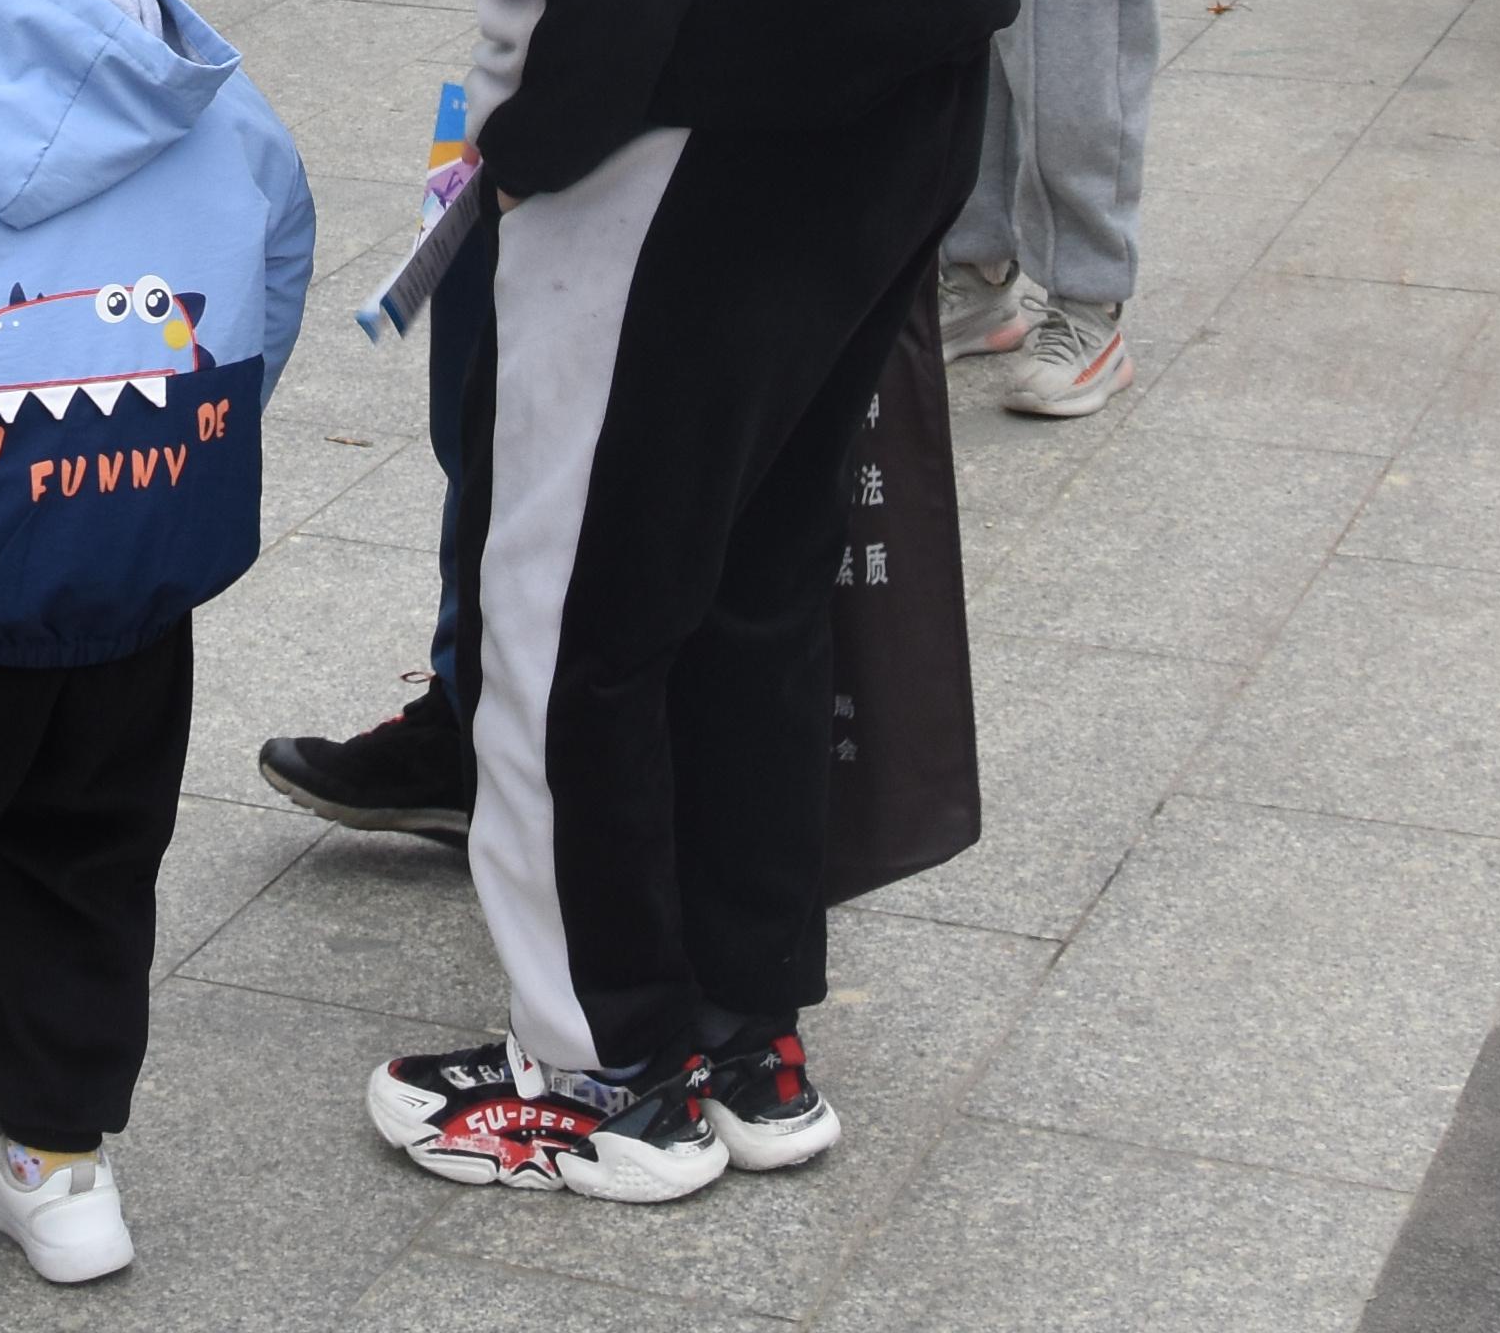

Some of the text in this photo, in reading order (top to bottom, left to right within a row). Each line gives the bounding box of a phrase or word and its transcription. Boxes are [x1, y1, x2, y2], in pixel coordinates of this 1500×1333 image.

[30, 443, 187, 502] FUNNY
[852, 464, 884, 506] 法
[465, 1105, 576, 1136] SU-PER
